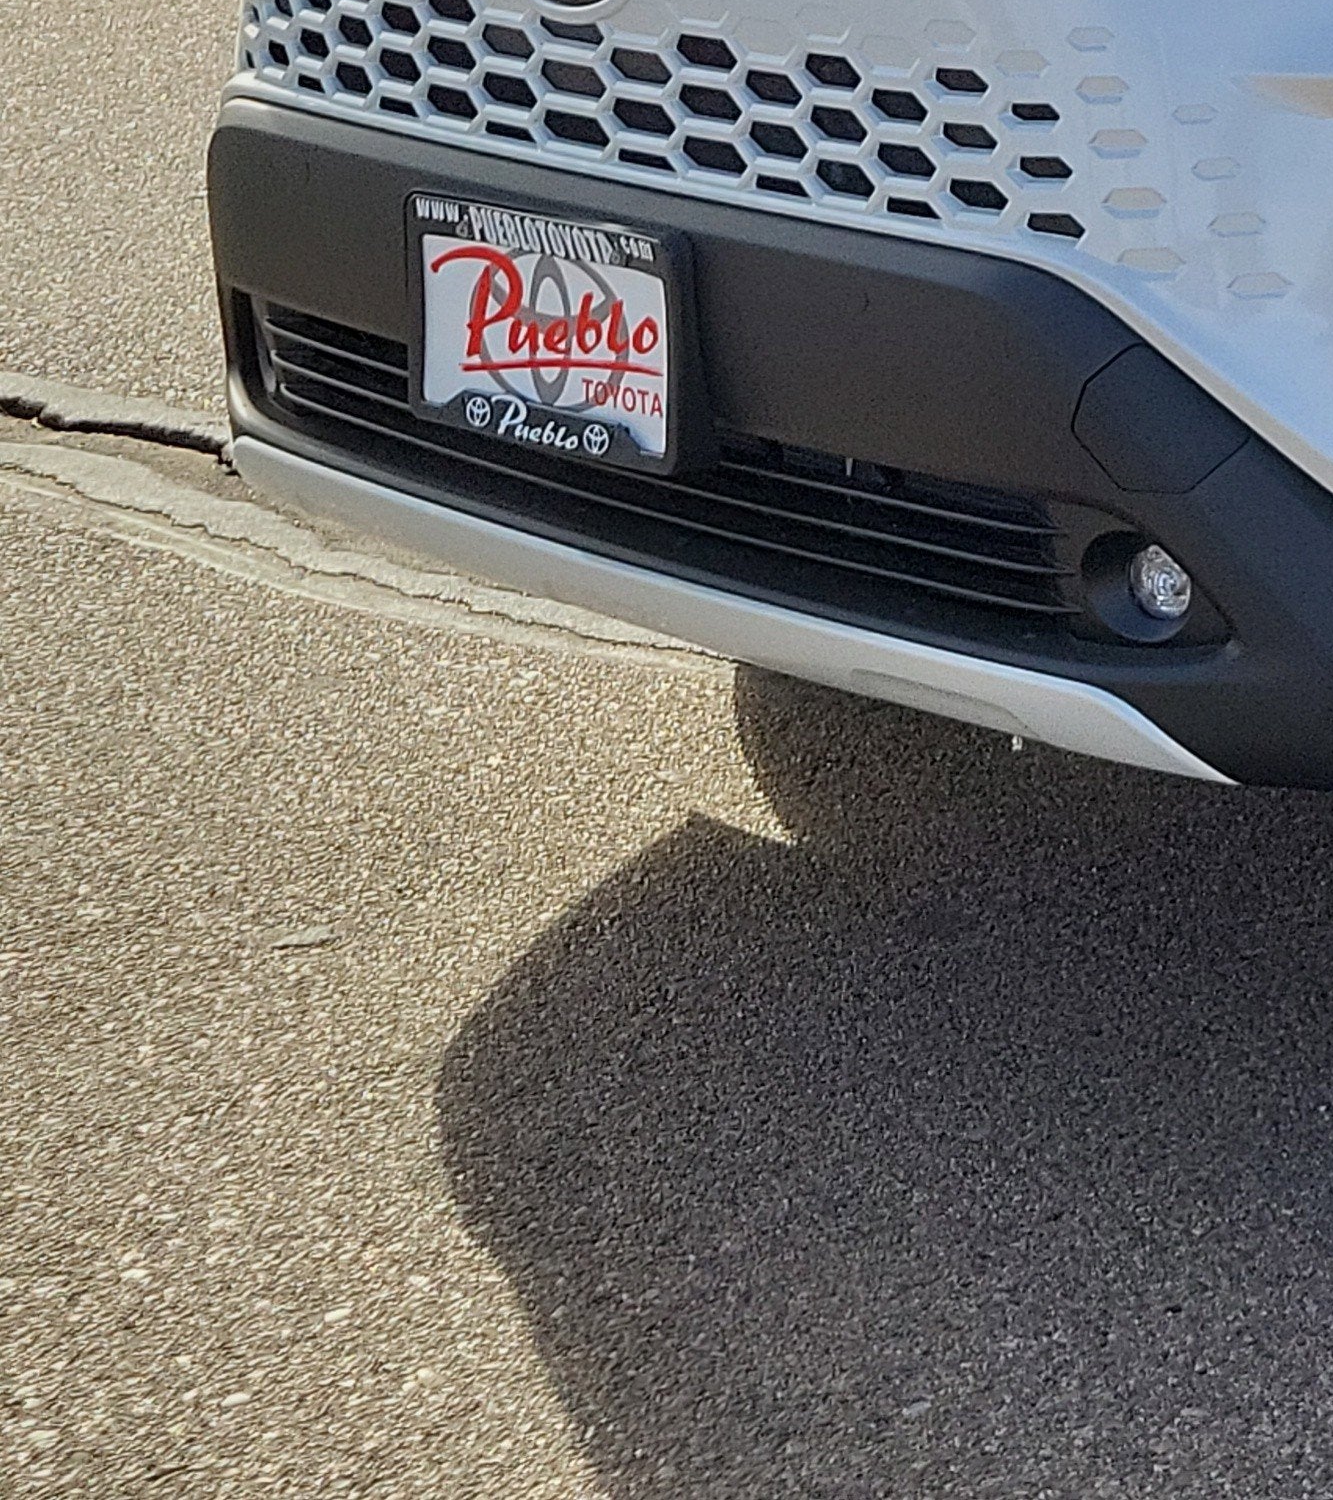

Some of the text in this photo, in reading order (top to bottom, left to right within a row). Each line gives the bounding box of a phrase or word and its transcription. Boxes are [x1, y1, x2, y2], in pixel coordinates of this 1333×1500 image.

[430, 246, 659, 358] Pueblo
[491, 394, 579, 451] Pueblo
[582, 377, 663, 419] TOYOTA
